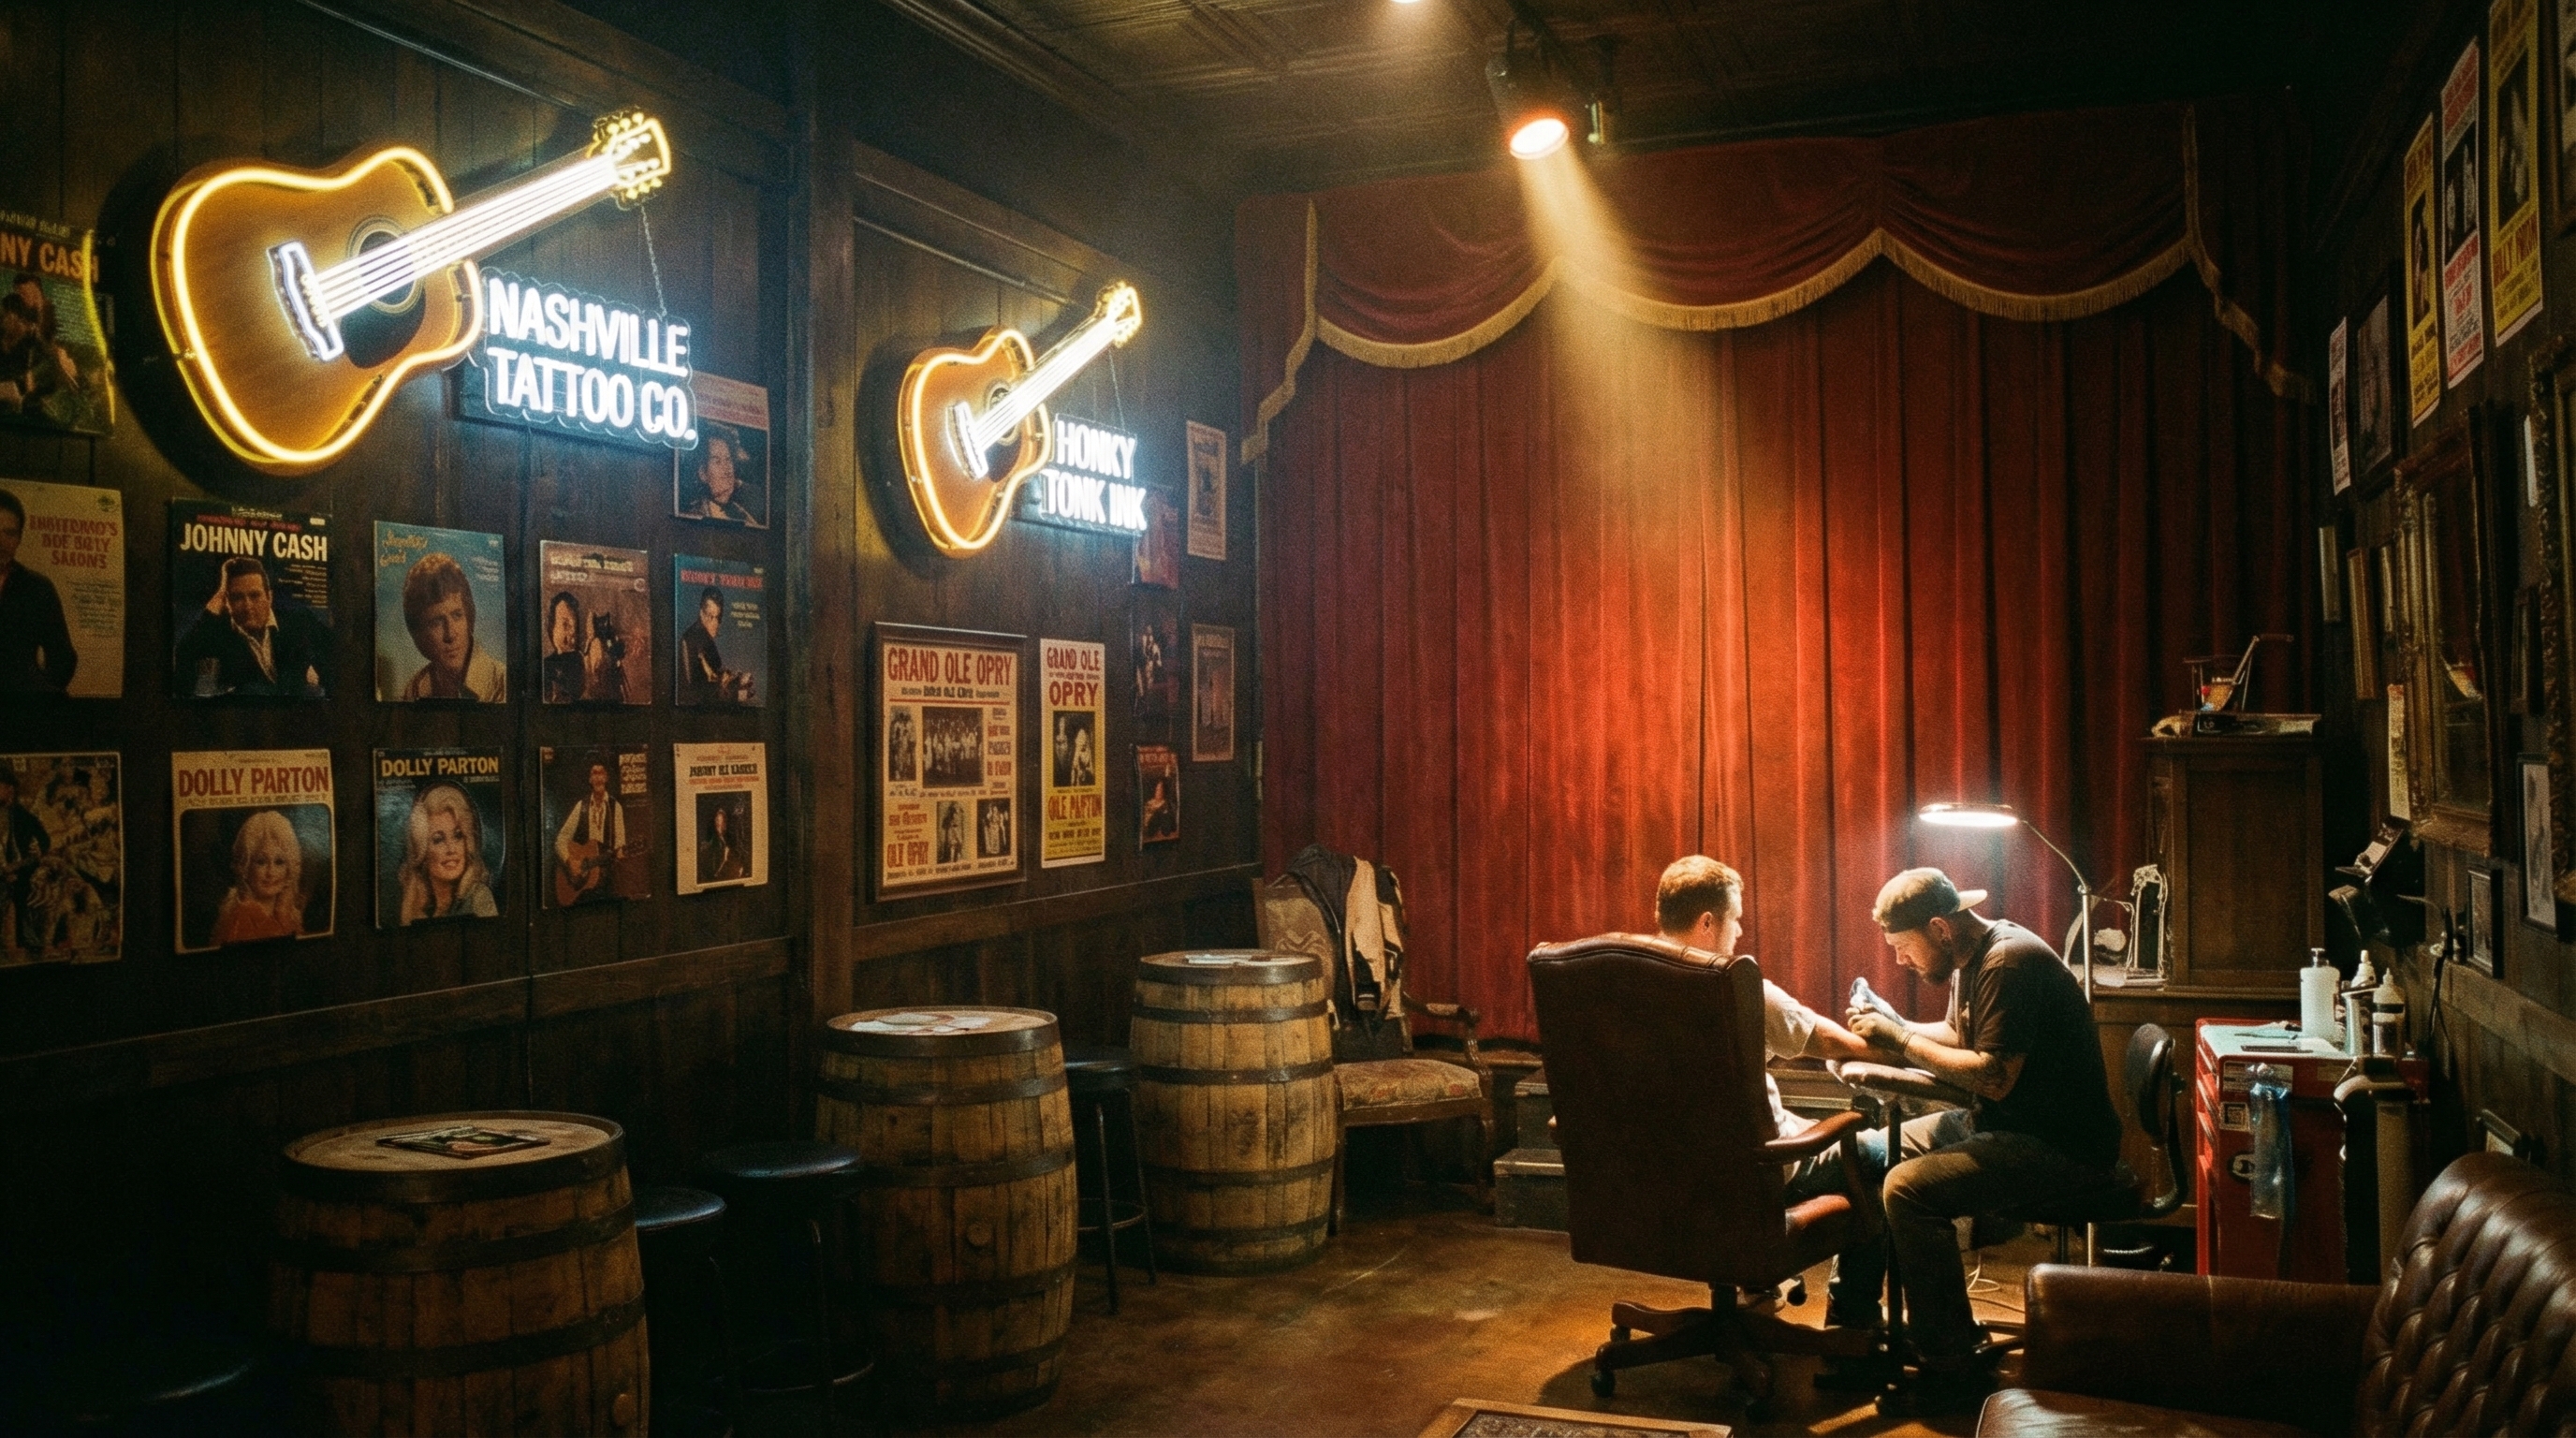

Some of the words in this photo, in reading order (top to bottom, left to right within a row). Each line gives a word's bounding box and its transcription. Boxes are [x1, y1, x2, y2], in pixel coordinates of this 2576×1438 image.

[489, 277, 689, 377] NASHVILLE
[486, 347, 635, 428] TATTOO
[640, 381, 696, 440] CO.
[1057, 420, 1135, 479] HONKY
[1042, 468, 1106, 524] TONK
[1109, 482, 1148, 531] INK
[180, 522, 268, 556] JOHNNY
[273, 532, 328, 562] CASH
[887, 647, 940, 683] GRAND
[944, 652, 972, 684] OLE
[976, 654, 1012, 685] OPRY
[1080, 649, 1100, 671] OLE
[1049, 681, 1099, 707] OPRY
[178, 768, 244, 798] DOLLY
[251, 766, 329, 795] PARTON
[381, 757, 433, 778] DOLLY
[437, 756, 500, 775] PARTON
